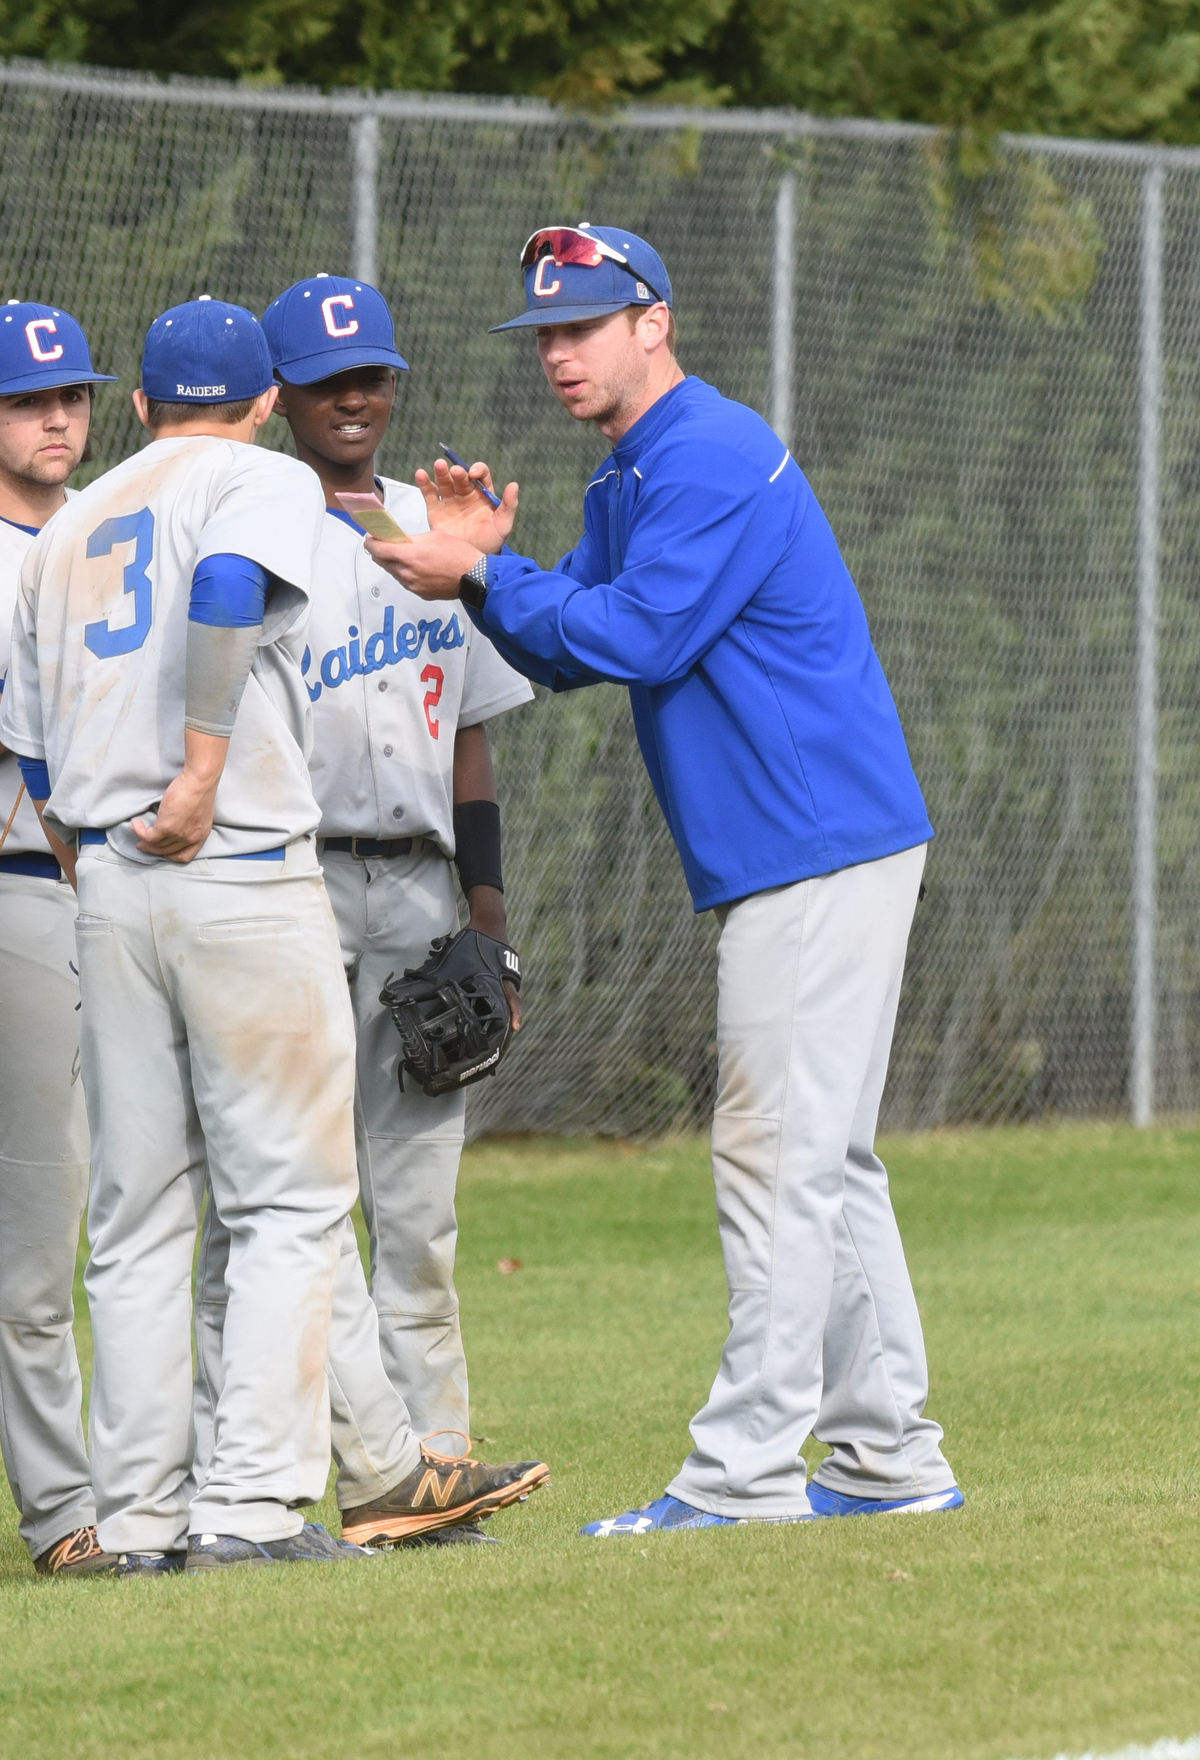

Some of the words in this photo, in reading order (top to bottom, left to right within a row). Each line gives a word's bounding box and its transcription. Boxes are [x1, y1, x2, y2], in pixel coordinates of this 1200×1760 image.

[534, 254, 562, 297] C
[321, 294, 358, 338] C
[25, 318, 65, 363] C
[176, 384, 227, 397] RAIDERS
[84, 506, 156, 660] 3
[420, 663, 444, 740] 2
[411, 1468, 463, 1508] N
